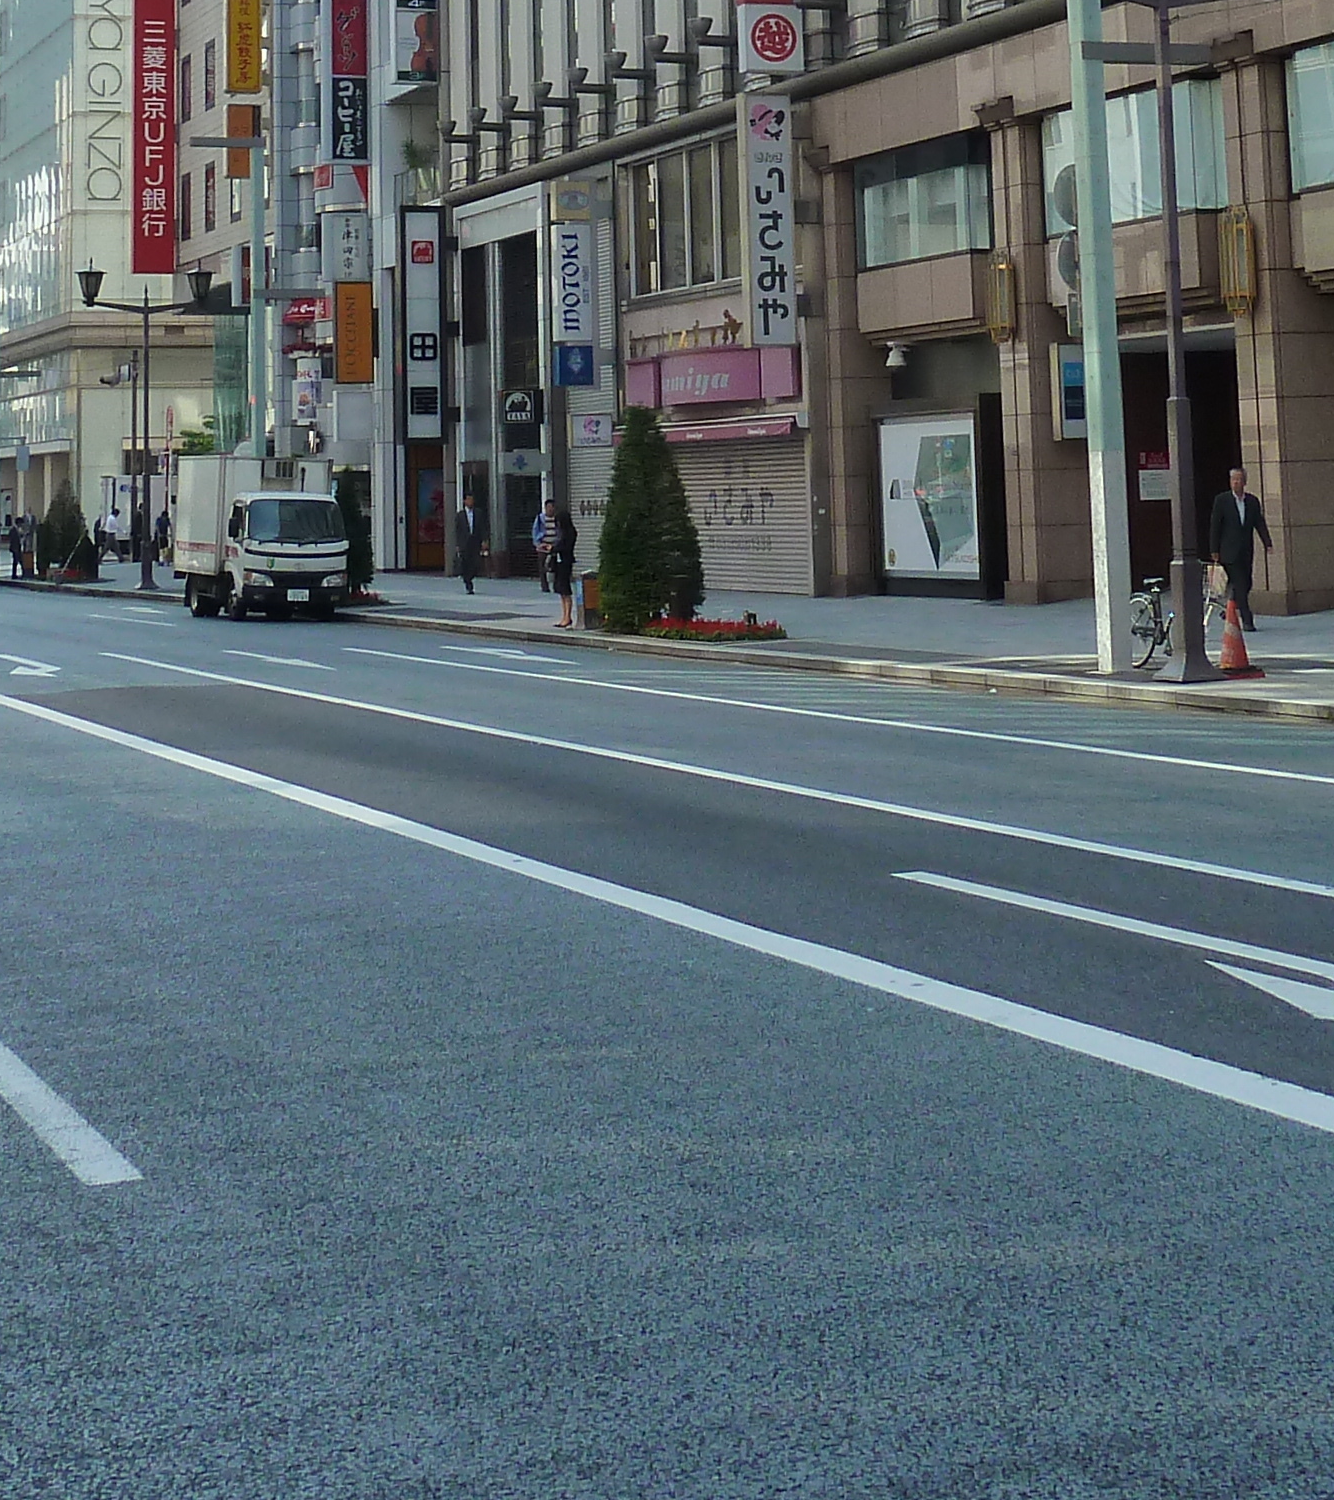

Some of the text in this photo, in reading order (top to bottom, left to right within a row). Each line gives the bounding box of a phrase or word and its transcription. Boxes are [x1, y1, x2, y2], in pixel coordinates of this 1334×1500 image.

[141, 19, 168, 238] 三菱東京UFJ銀行
[336, 80, 356, 158] コーヒー屋
[754, 167, 790, 336] いさみや
